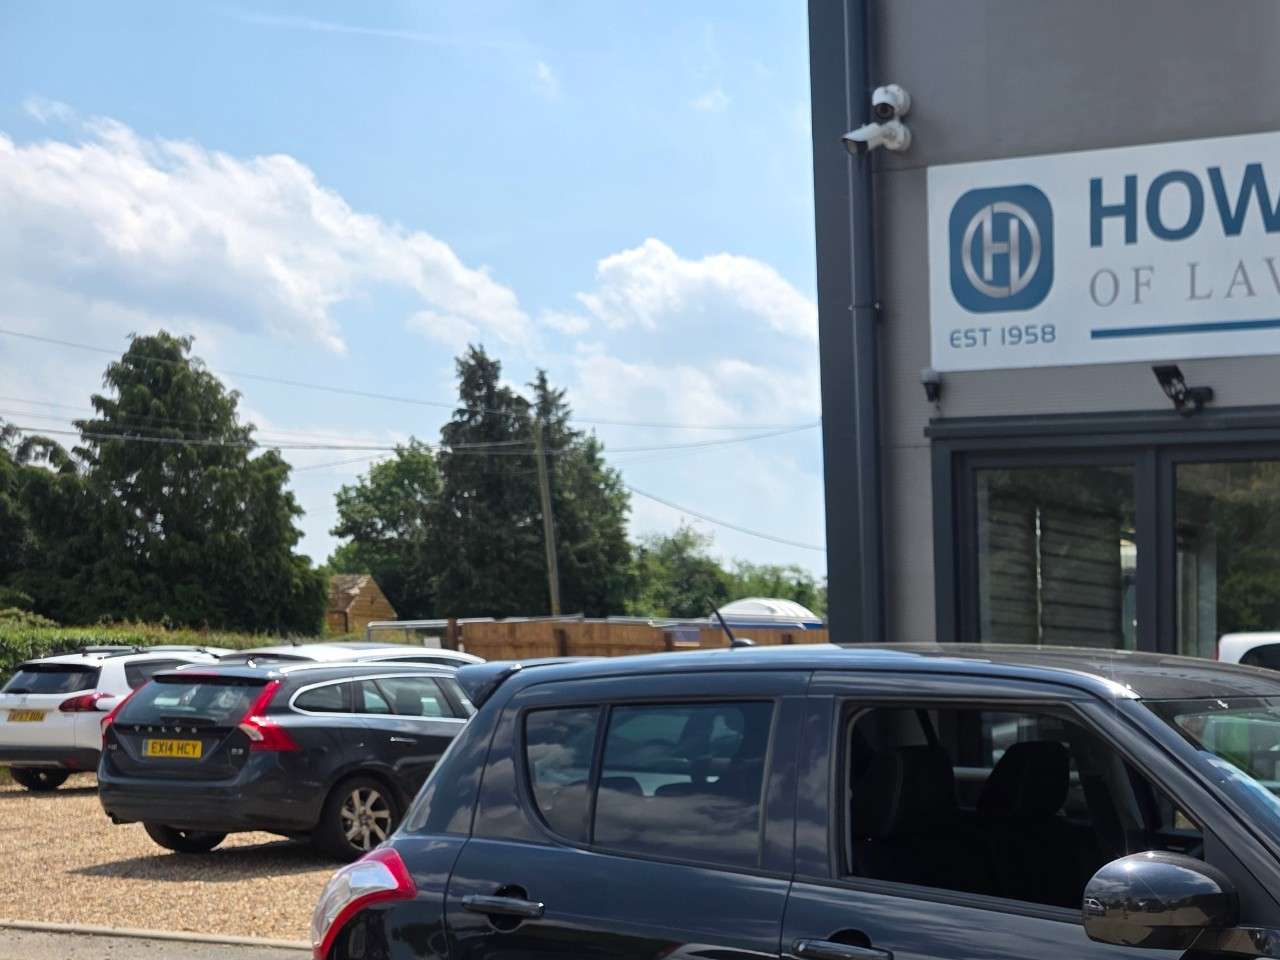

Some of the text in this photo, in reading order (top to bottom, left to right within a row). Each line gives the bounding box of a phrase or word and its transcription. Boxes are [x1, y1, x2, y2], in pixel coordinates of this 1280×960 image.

[1089, 265, 1156, 308] OF
[950, 324, 1057, 349] EST 1958
[151, 741, 198, 756] EX14 HCY
